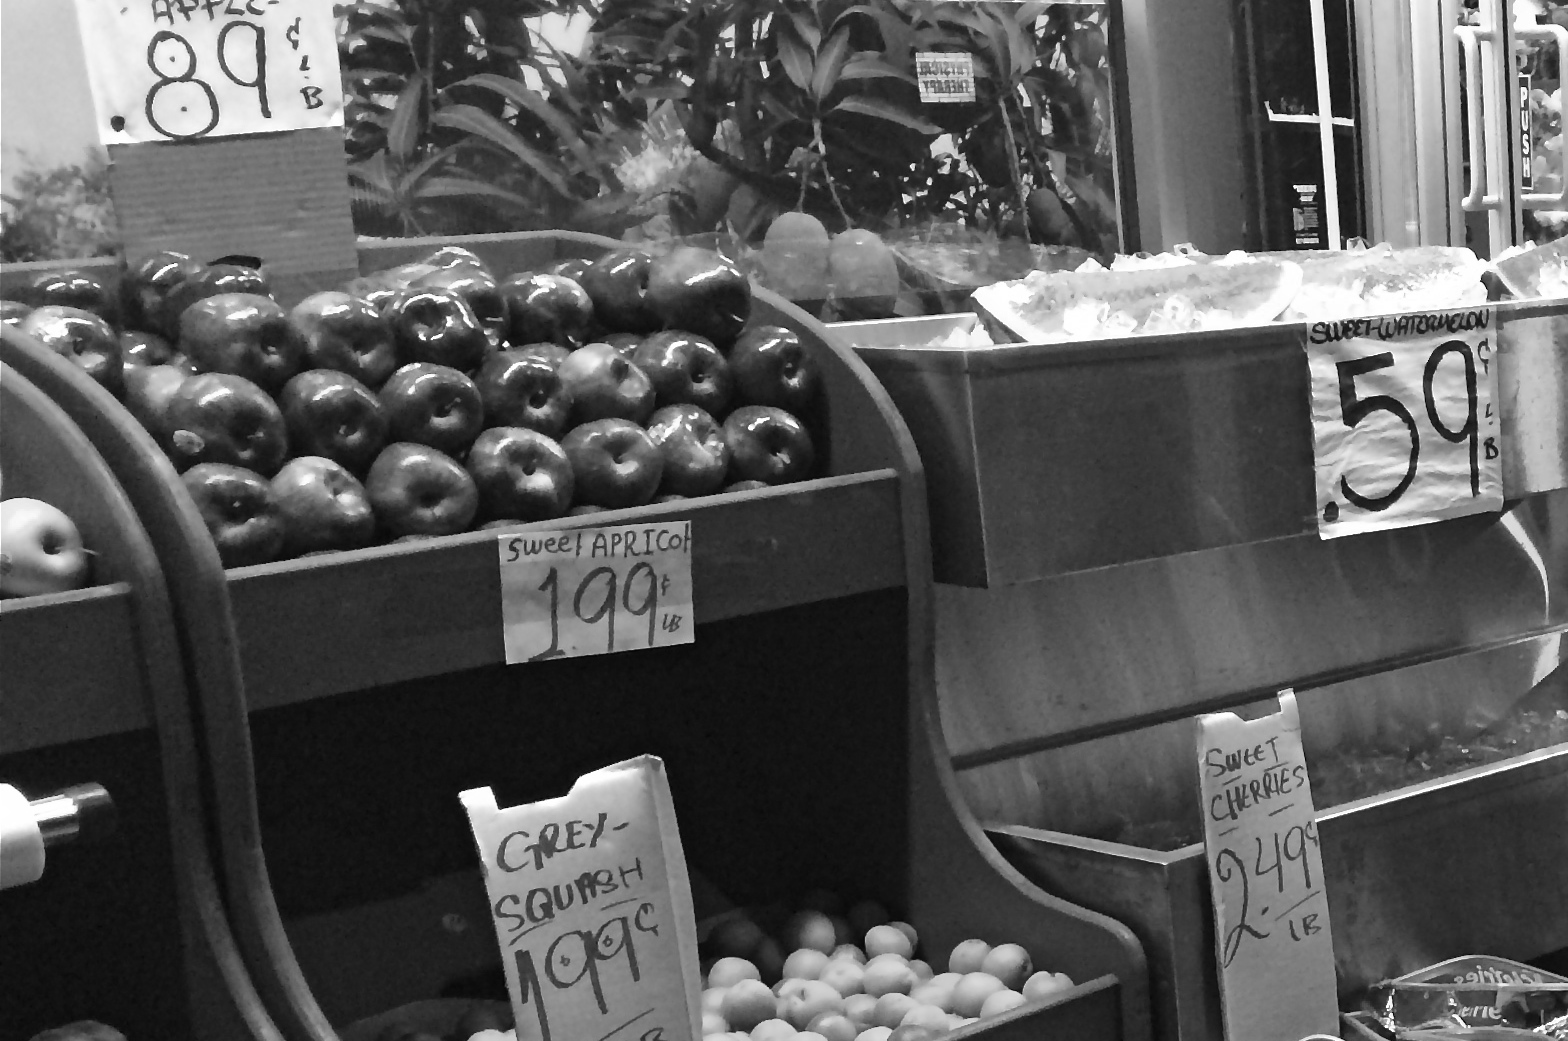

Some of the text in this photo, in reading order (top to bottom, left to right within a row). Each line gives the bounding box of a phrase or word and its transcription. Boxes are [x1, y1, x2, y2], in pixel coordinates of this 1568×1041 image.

[1520, 86, 1531, 178] PUSH
[1206, 736, 1279, 778] SWEET
[1210, 764, 1306, 822] CHERRIES
[494, 856, 643, 932] SQUASH
